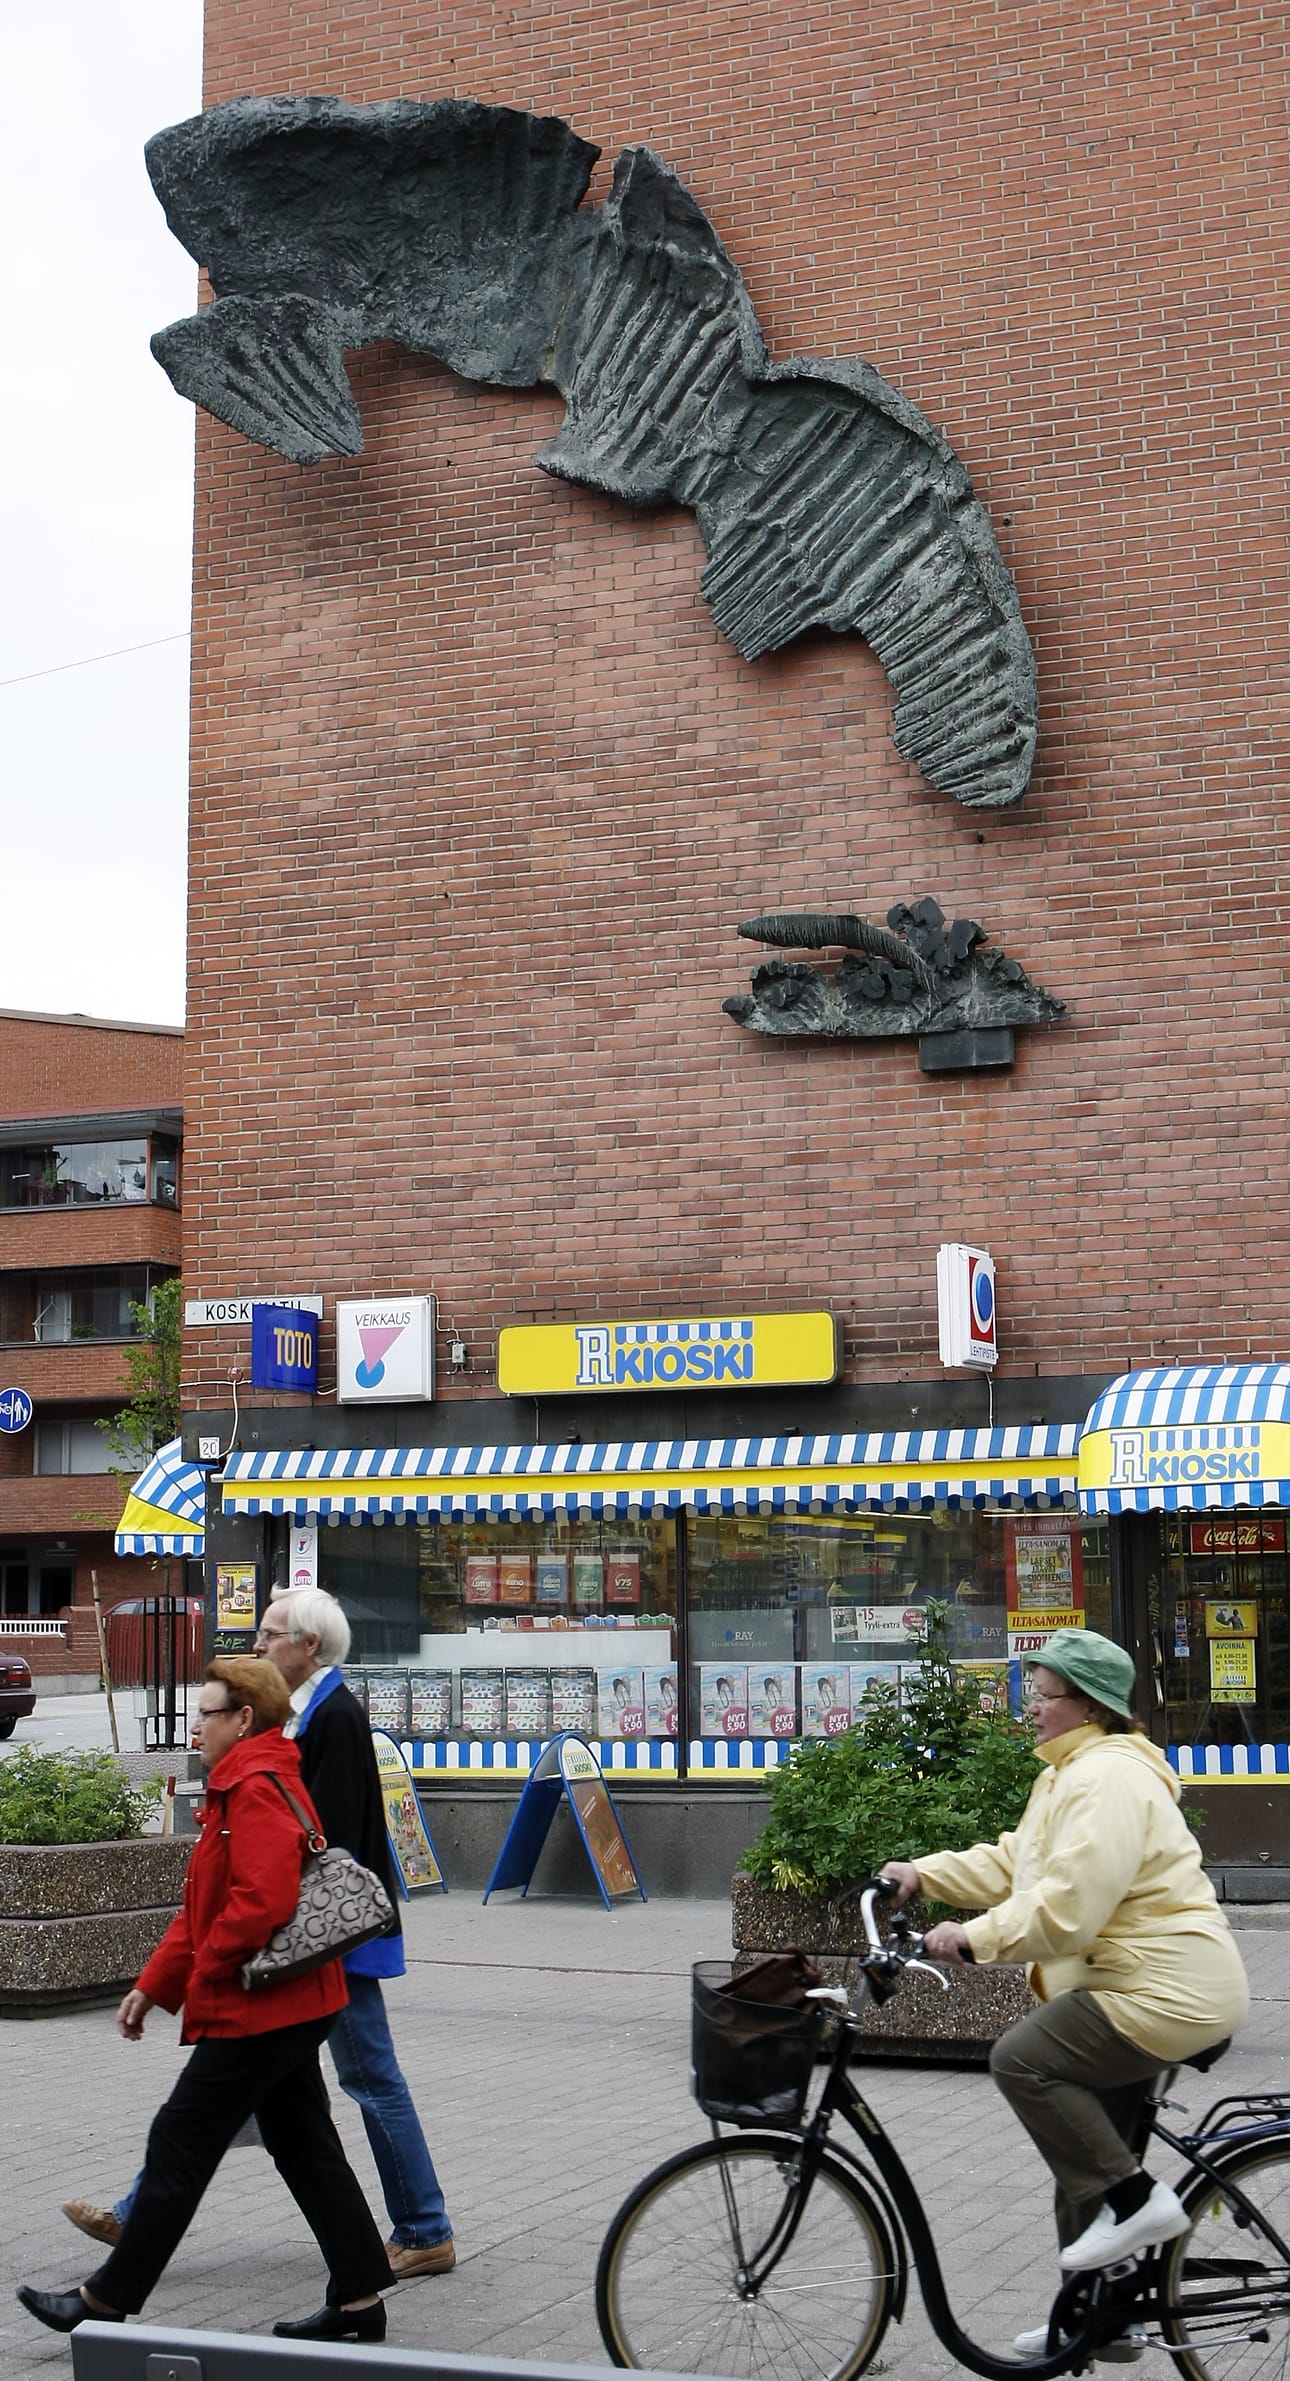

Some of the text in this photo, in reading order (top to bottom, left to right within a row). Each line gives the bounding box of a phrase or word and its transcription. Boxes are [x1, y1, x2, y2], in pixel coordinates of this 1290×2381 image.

[355, 1311, 411, 1327] VEIKKAUS
[273, 1327, 312, 1369] TOTO
[575, 1327, 754, 1385] R KIOSKI
[202, 1442, 217, 1456] 20
[1110, 1432, 1260, 1484] R KIOSKI
[294, 1575, 312, 1586] LOTTO
[614, 1578, 632, 1587] V75
[865, 1621, 901, 1631] Tyyli-extra
[735, 1631, 754, 1641] RAY
[982, 1627, 1002, 1637] RAY
[624, 1713, 642, 1723] NYT
[727, 1713, 745, 1723] NYT
[775, 1713, 793, 1723] NYT
[829, 1713, 847, 1723] NYT
[624, 1720, 642, 1732] 5,90
[727, 1720, 745, 1732] 5,90
[775, 1720, 793, 1732] 5,90
[829, 1720, 847, 1732] 5,90
